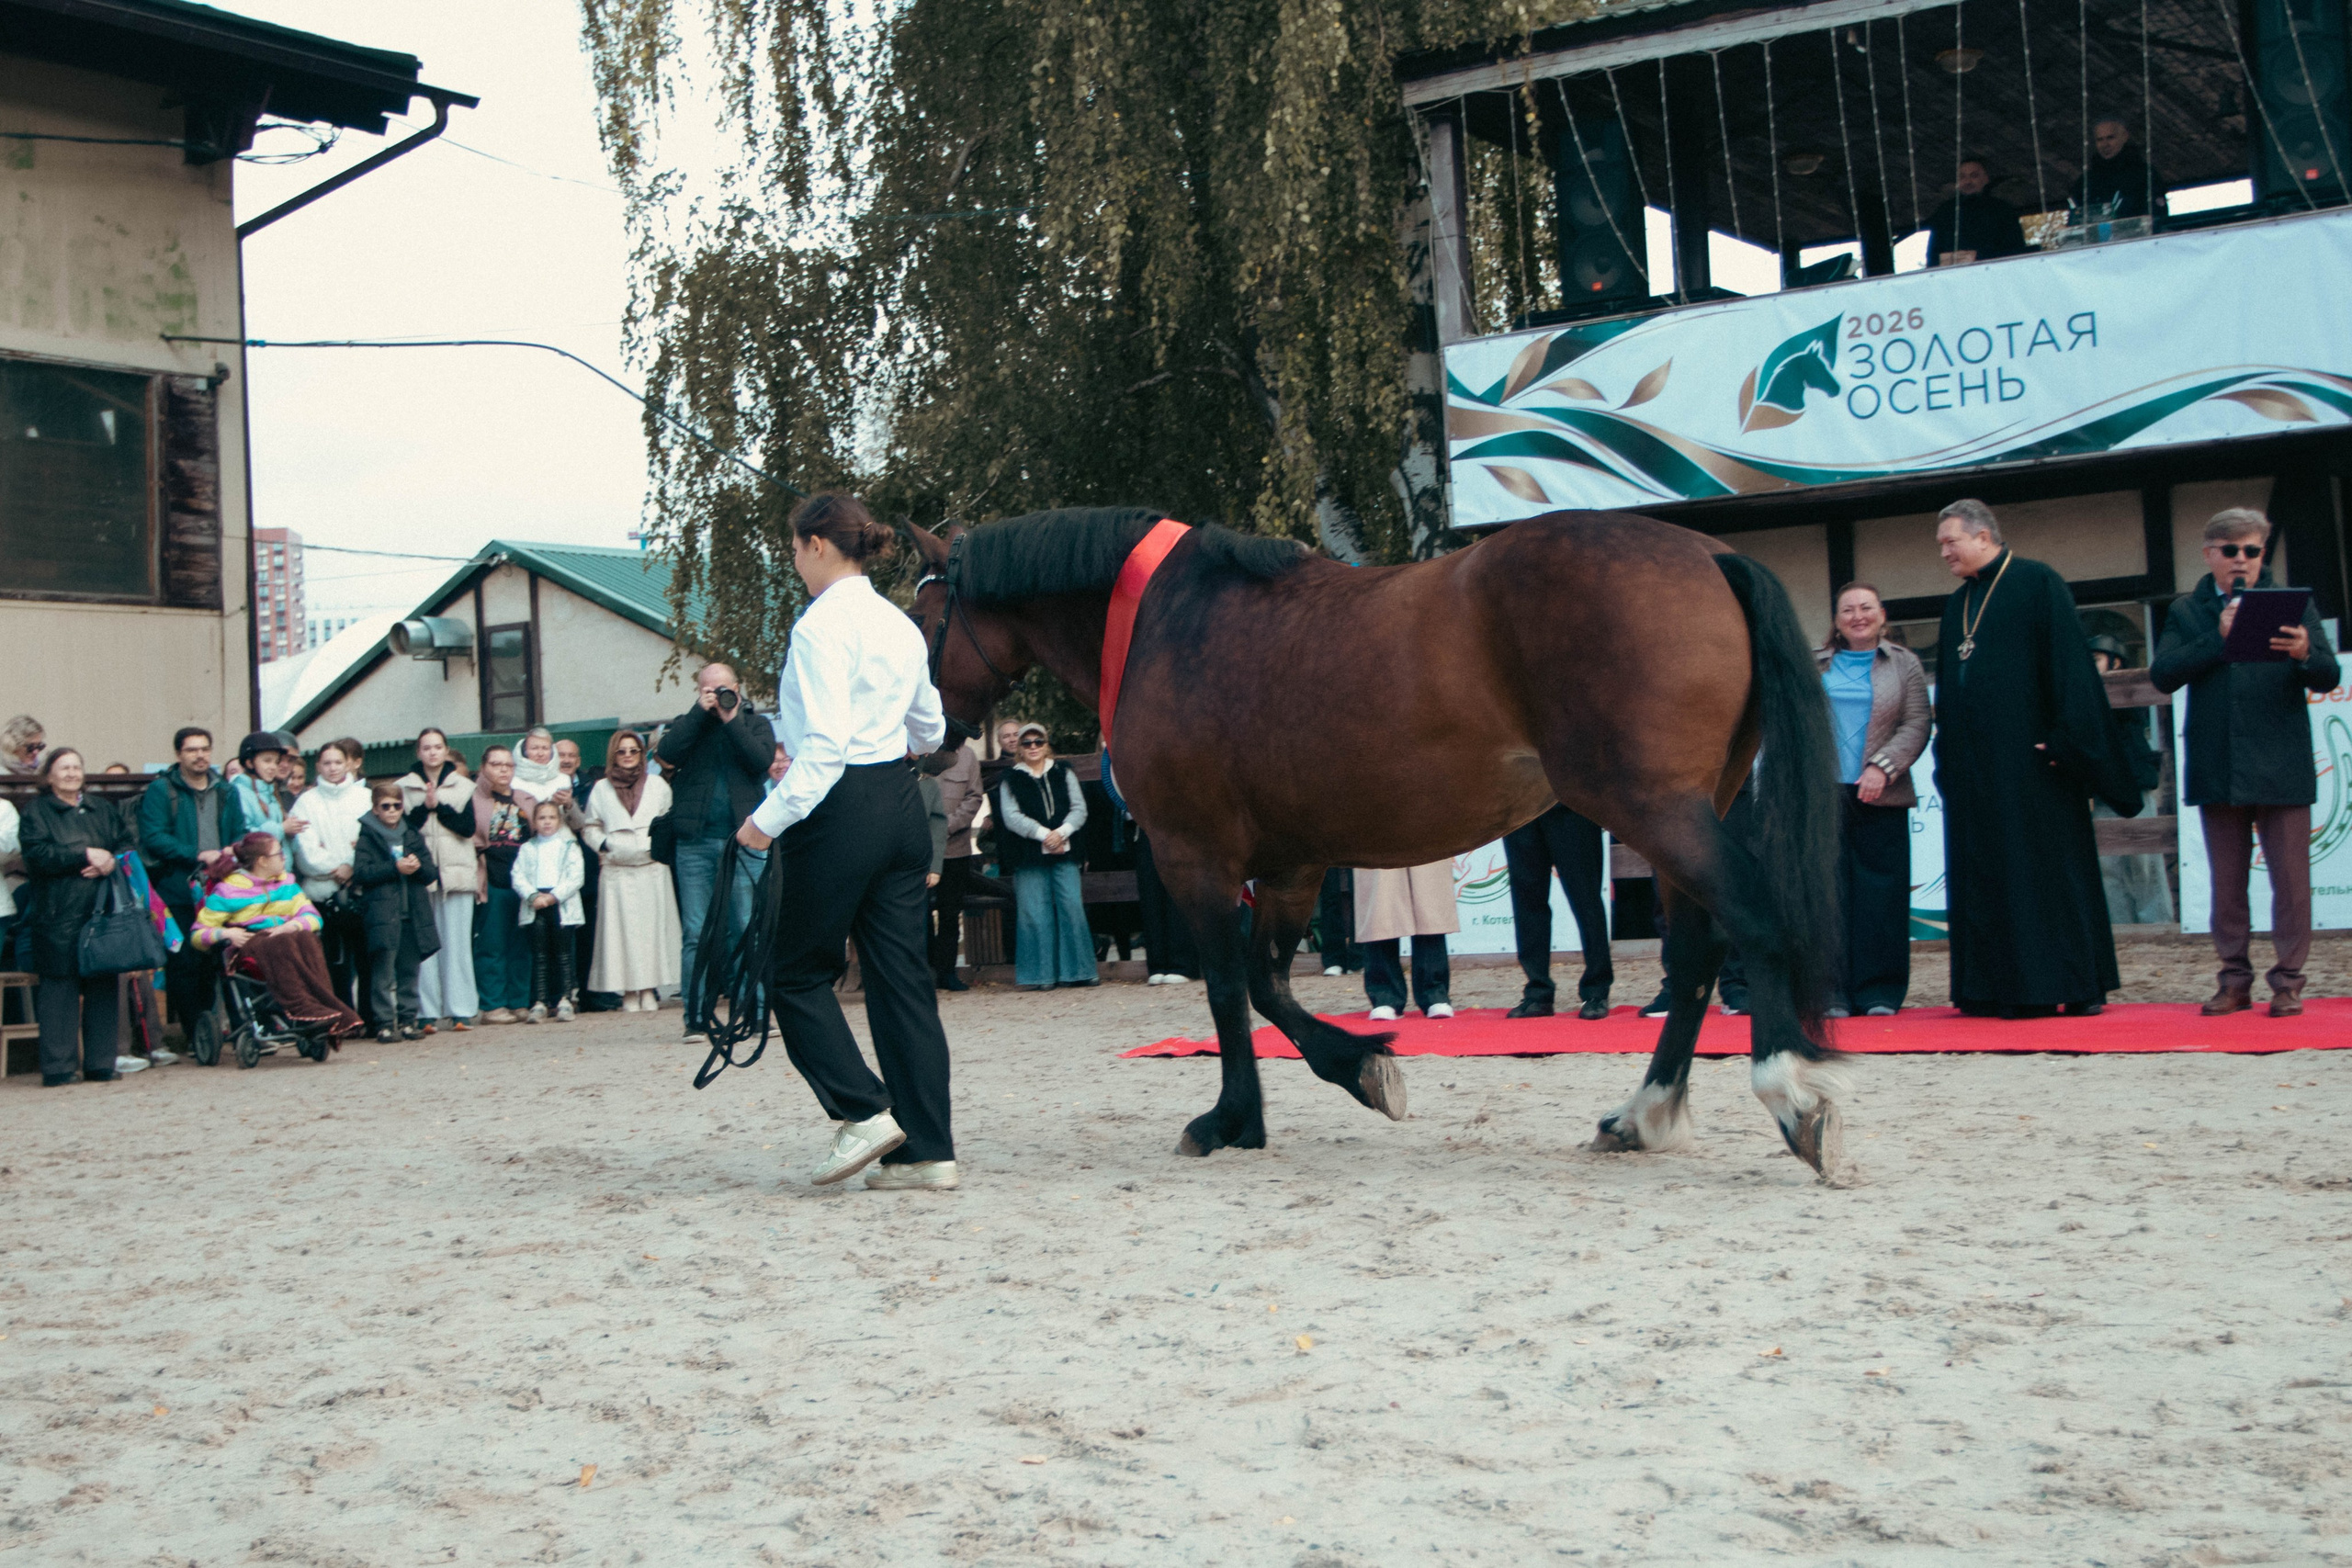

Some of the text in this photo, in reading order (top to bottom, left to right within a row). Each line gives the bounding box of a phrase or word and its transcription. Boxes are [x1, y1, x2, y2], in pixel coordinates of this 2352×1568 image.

[1847, 307, 1925, 339] 2026
[1848, 310, 2098, 379] ЗОЛОТАЯ
[1847, 367, 2026, 420] ОСЕНЬ
